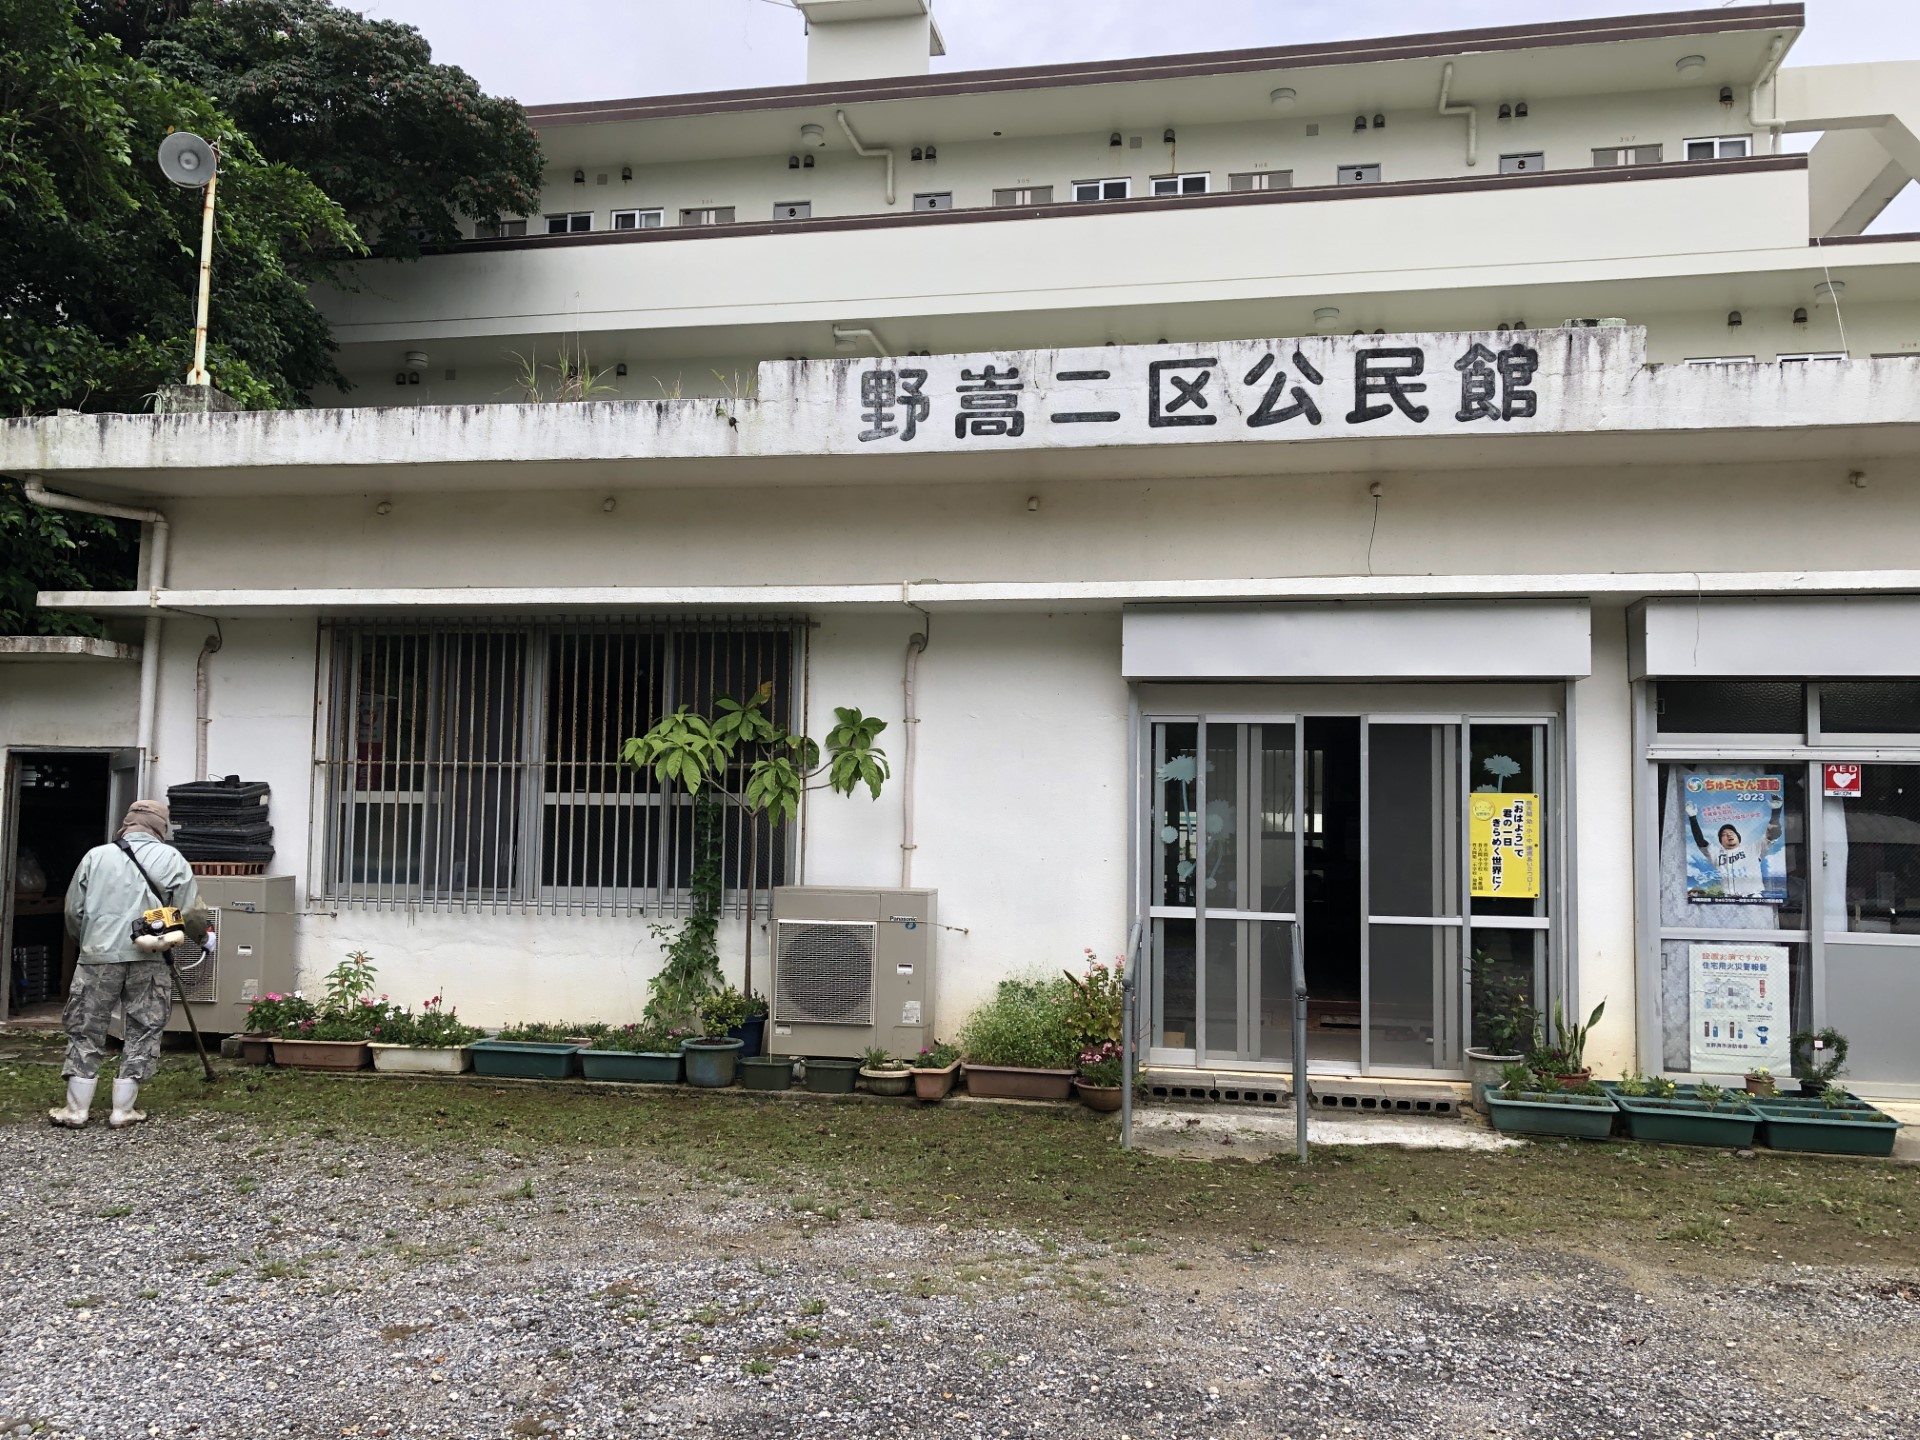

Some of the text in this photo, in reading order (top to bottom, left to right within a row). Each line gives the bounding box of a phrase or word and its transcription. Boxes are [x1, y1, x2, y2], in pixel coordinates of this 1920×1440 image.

[857, 342, 1539, 442] 野嵩二区公民館
[1704, 779, 1780, 791] ちゅらさん運動
[1737, 793, 1765, 801] 2023
[1503, 809, 1513, 846] 君の一日
[1514, 800, 1524, 857] 「おはよう」で
